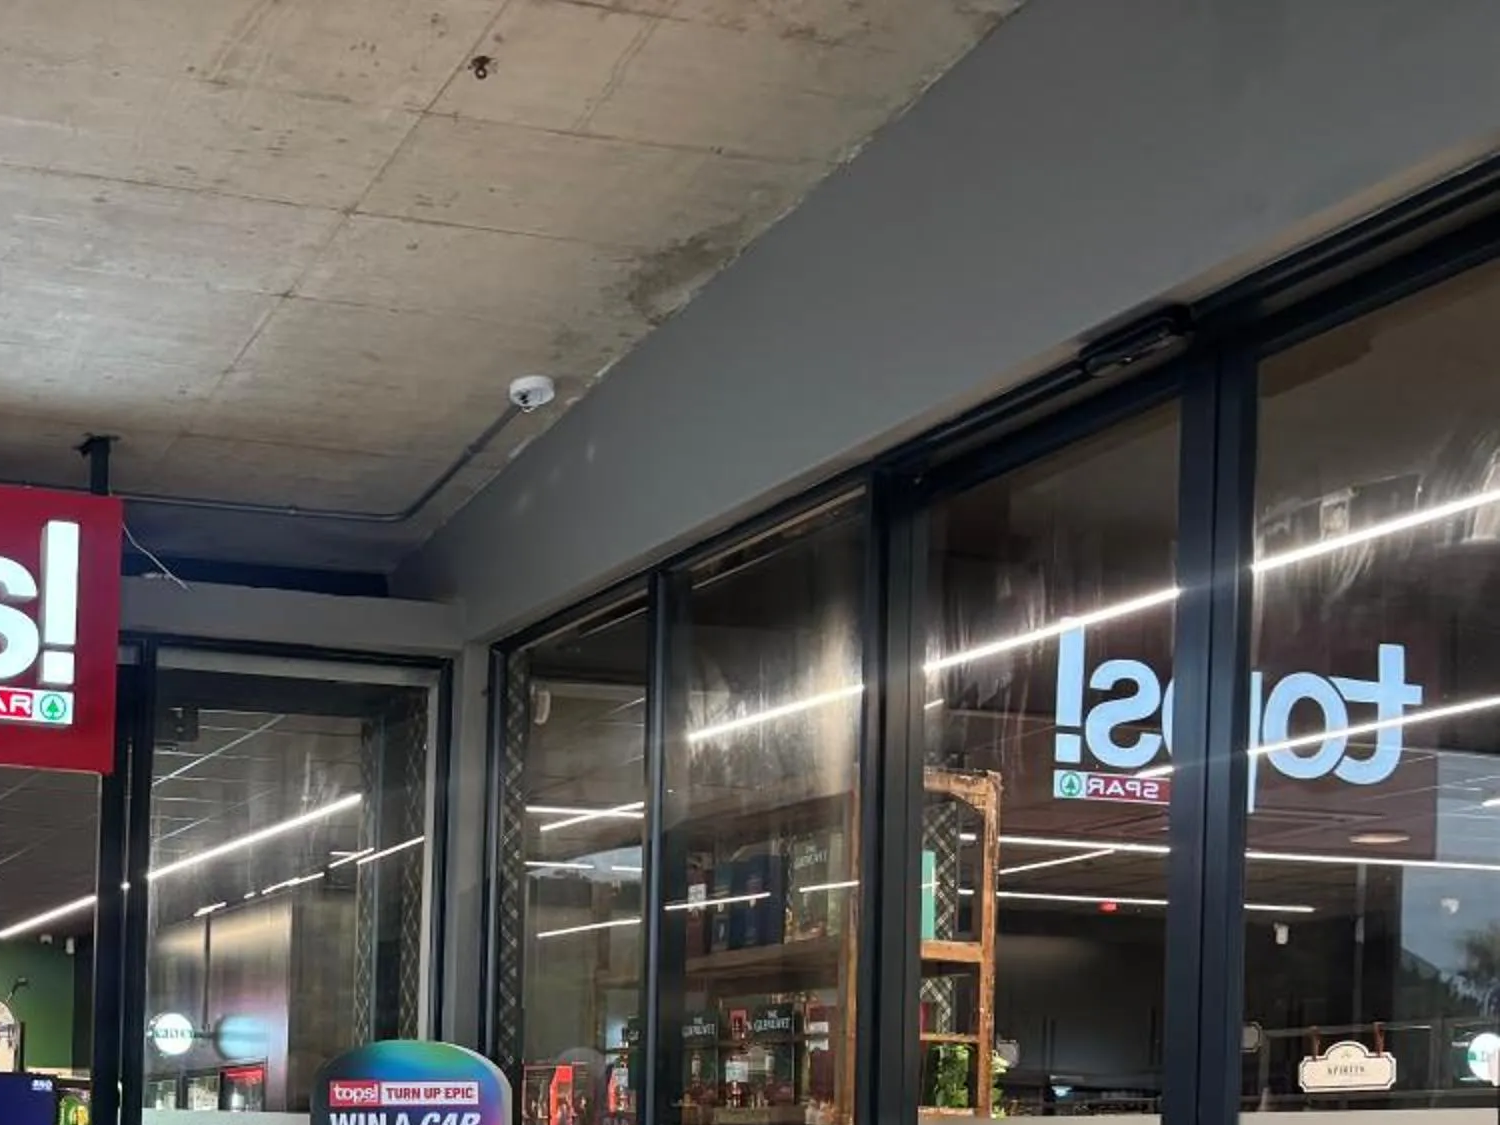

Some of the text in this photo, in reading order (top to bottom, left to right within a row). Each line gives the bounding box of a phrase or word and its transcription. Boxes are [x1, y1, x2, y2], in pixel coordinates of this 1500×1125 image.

[333, 1083, 474, 1104] tops! TURN UP EPIC
